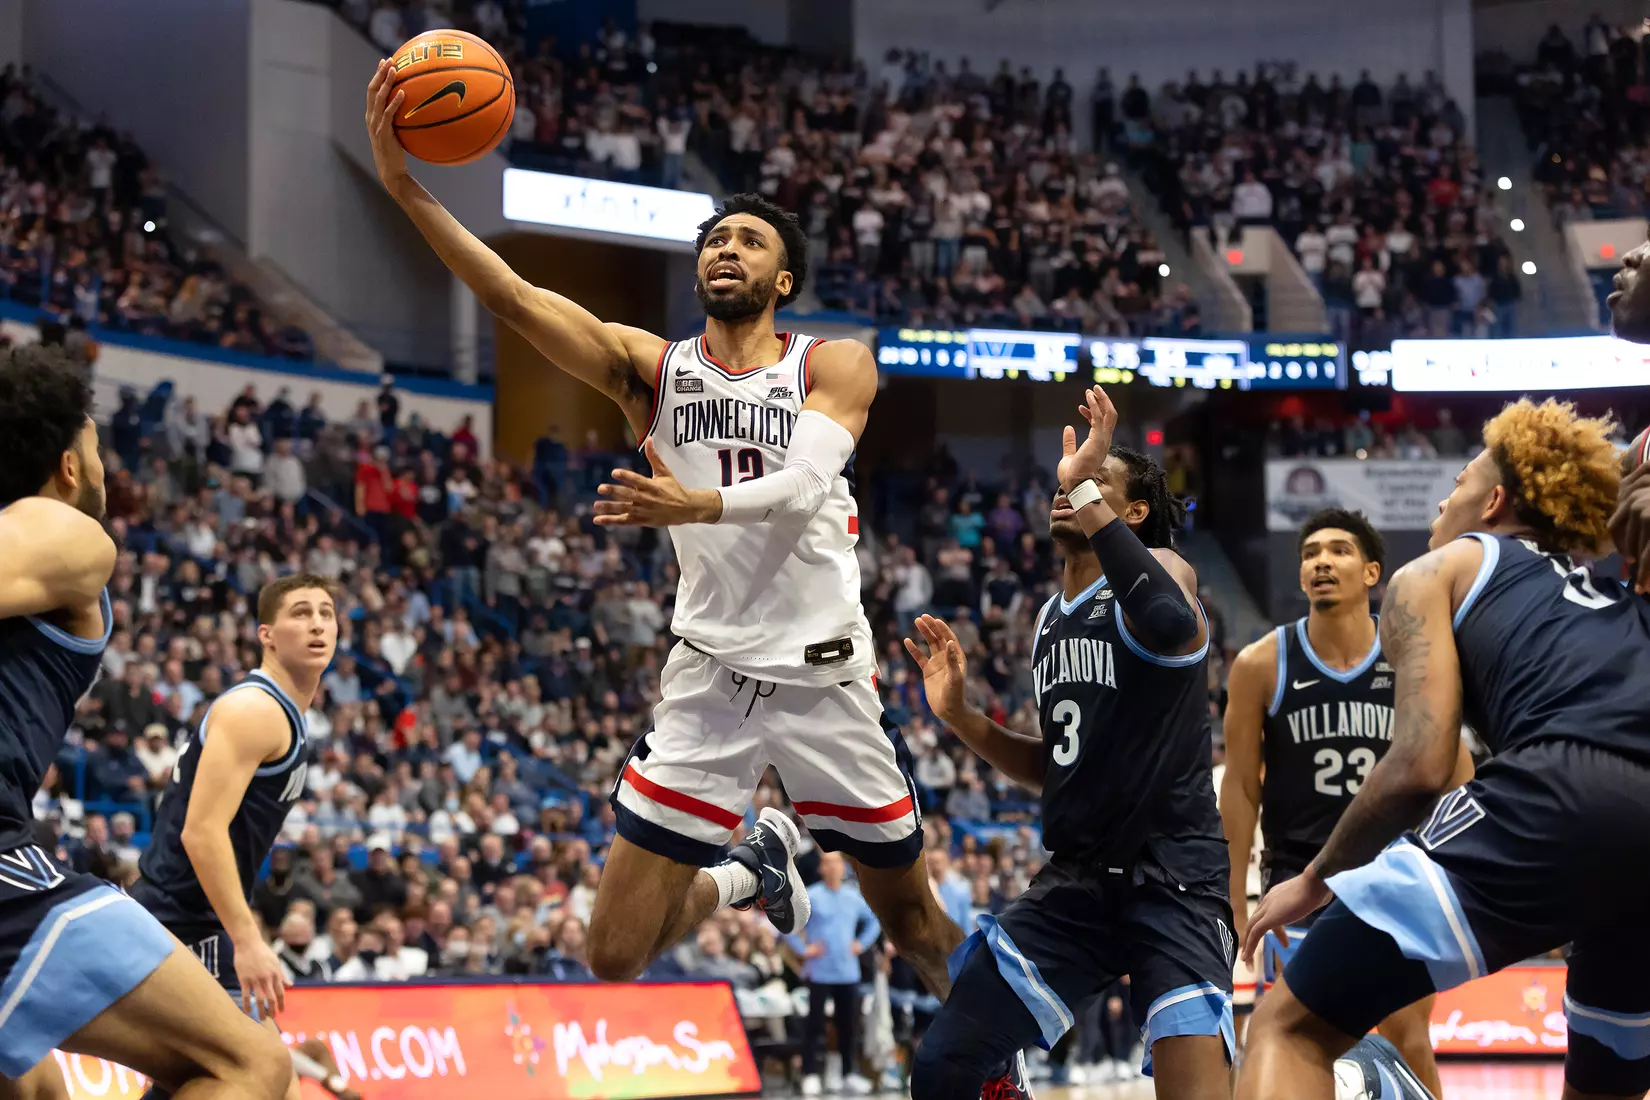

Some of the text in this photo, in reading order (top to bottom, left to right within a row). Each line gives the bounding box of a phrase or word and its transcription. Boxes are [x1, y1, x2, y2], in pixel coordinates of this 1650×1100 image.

[766, 391, 794, 399] EAST
[673, 398, 798, 449] CONNECTICU
[1052, 699, 1081, 766] 3
[1313, 747, 1376, 796] 23
